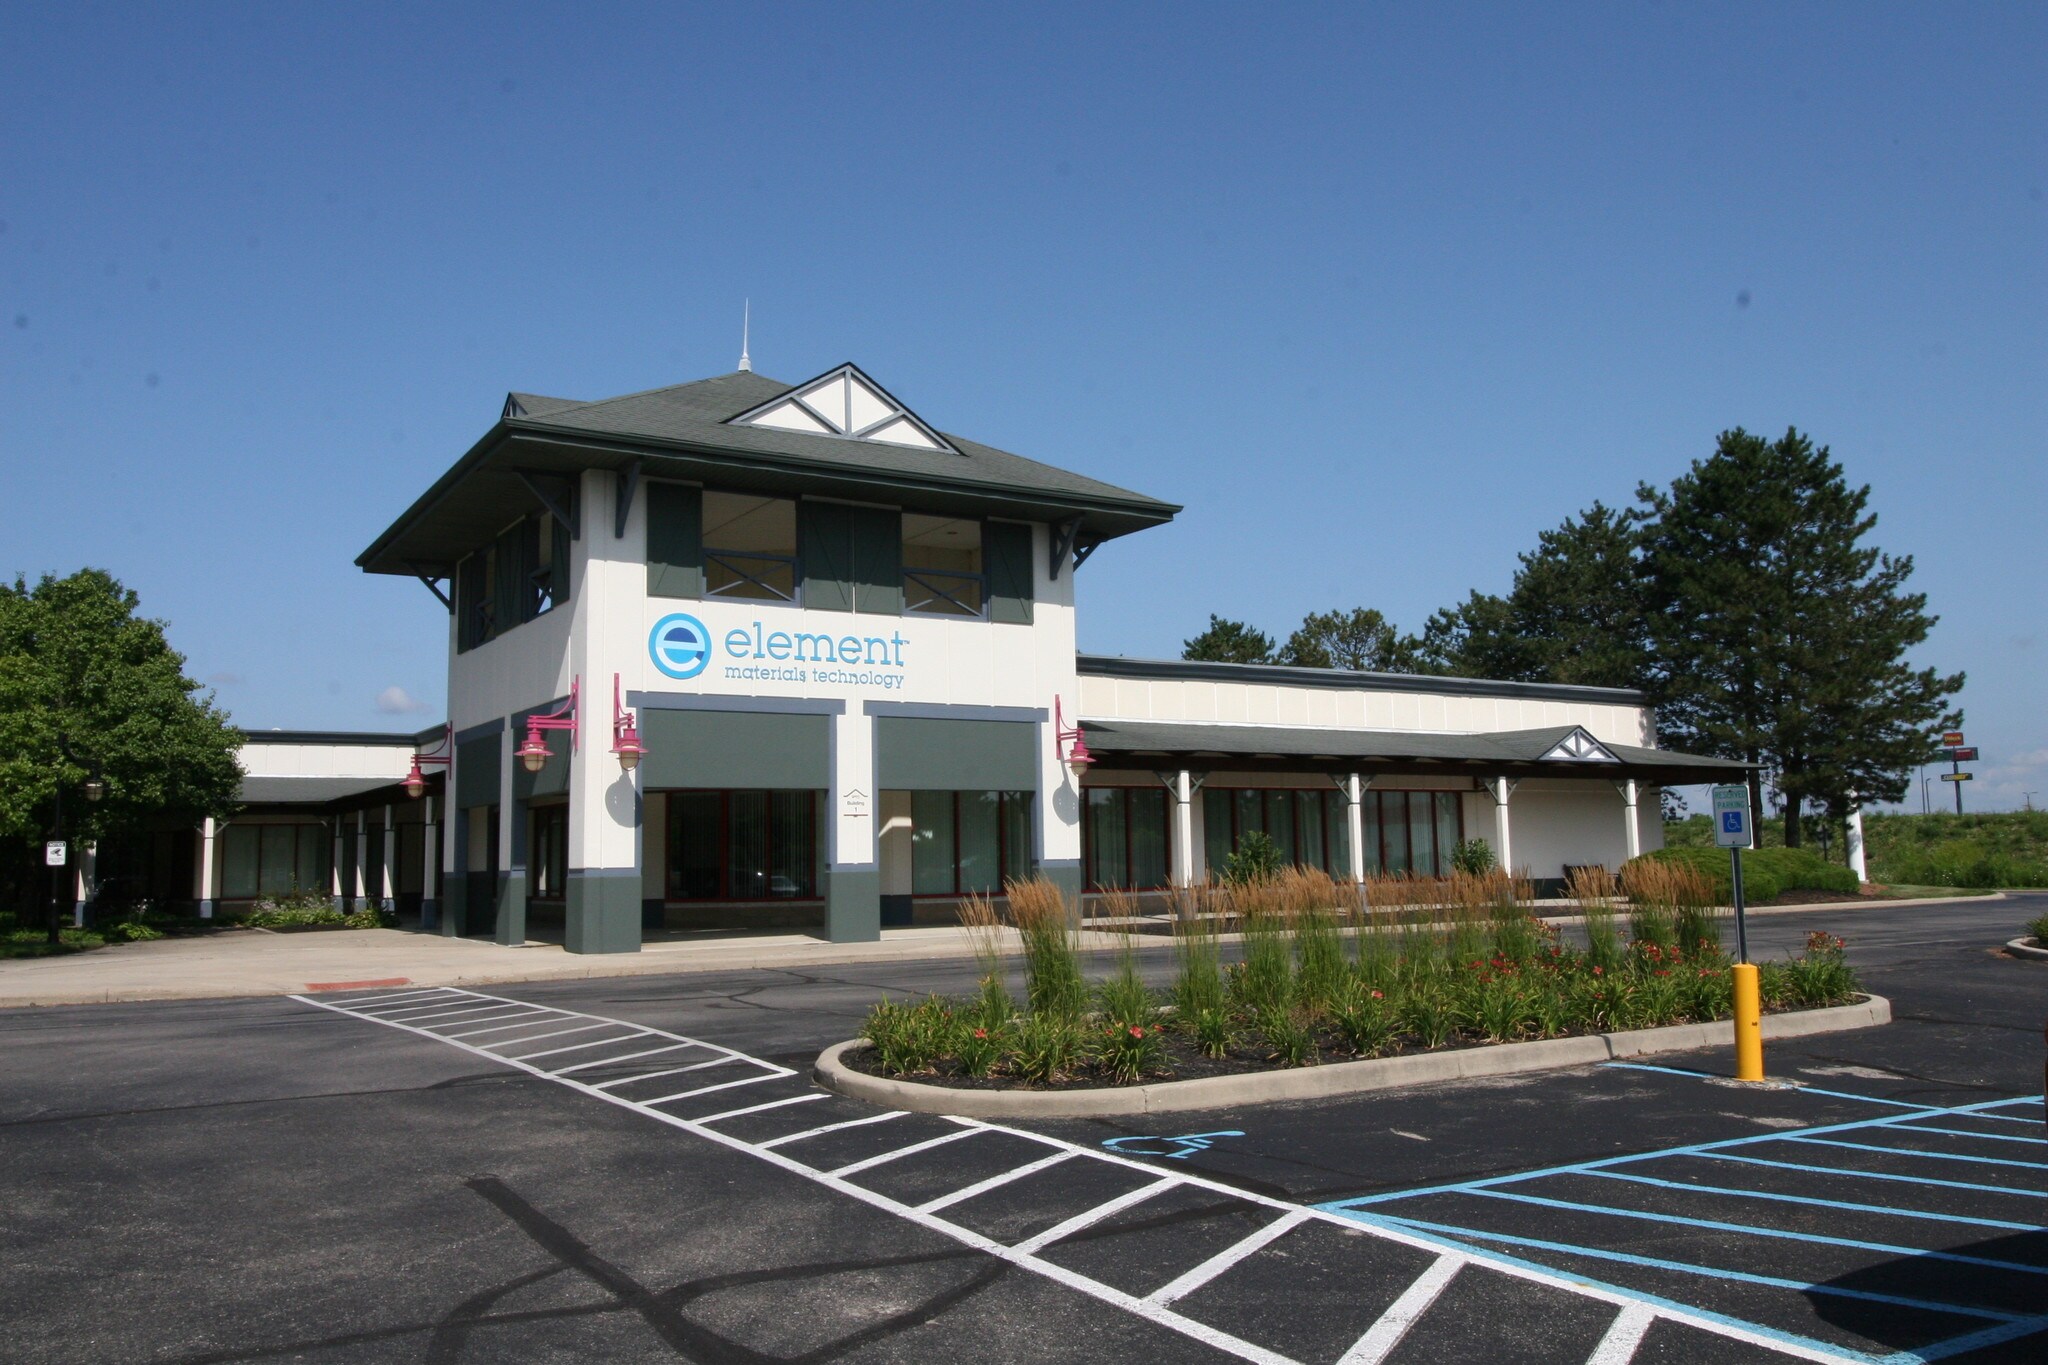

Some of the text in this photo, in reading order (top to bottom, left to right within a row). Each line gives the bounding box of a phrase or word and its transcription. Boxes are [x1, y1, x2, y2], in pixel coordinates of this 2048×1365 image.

[724, 621, 905, 666] element
[724, 665, 904, 689] materials technology
[1714, 791, 1745, 799] RESERVED
[1717, 801, 1745, 809] PARKING
